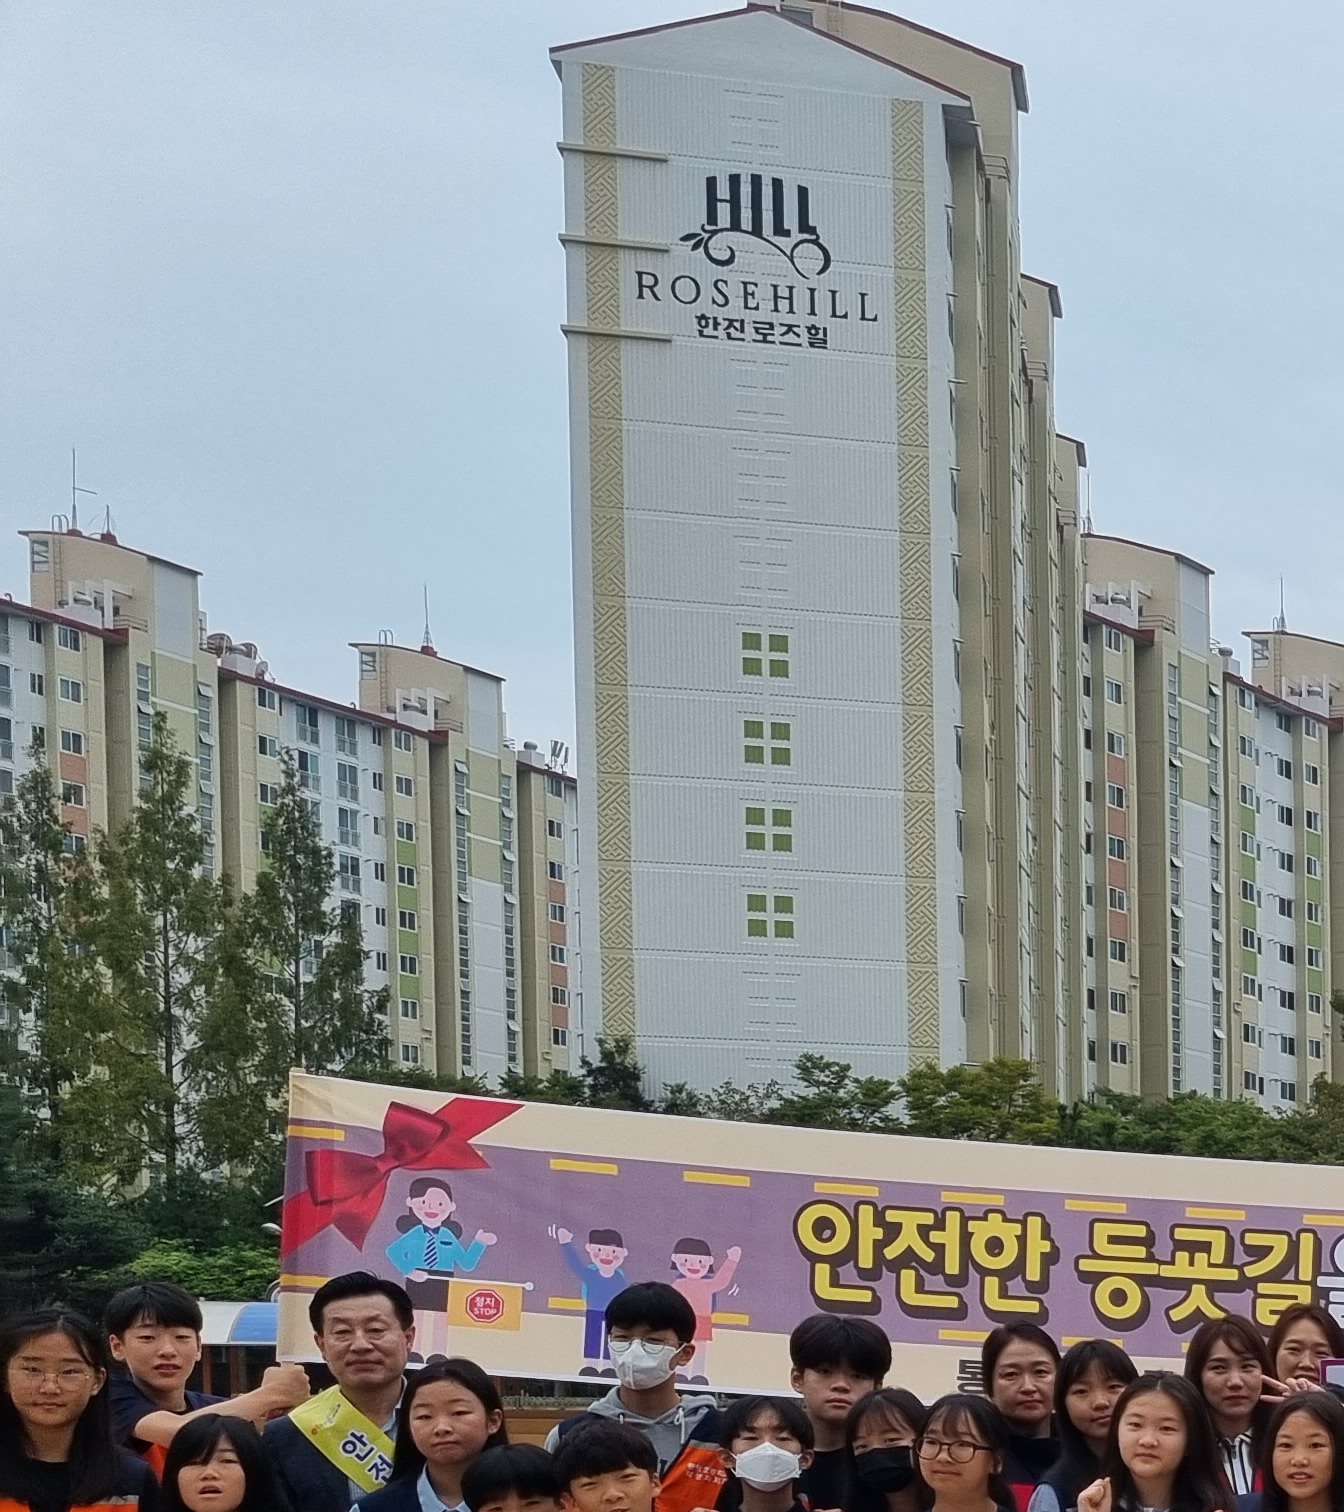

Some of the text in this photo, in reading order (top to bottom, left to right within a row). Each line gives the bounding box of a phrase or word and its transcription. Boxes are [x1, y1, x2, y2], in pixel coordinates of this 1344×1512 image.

[706, 173, 818, 238] HILL
[634, 270, 878, 322] ROSEHILL
[795, 1200, 1056, 1322] 안전한
[473, 1307, 497, 1316] STOP
